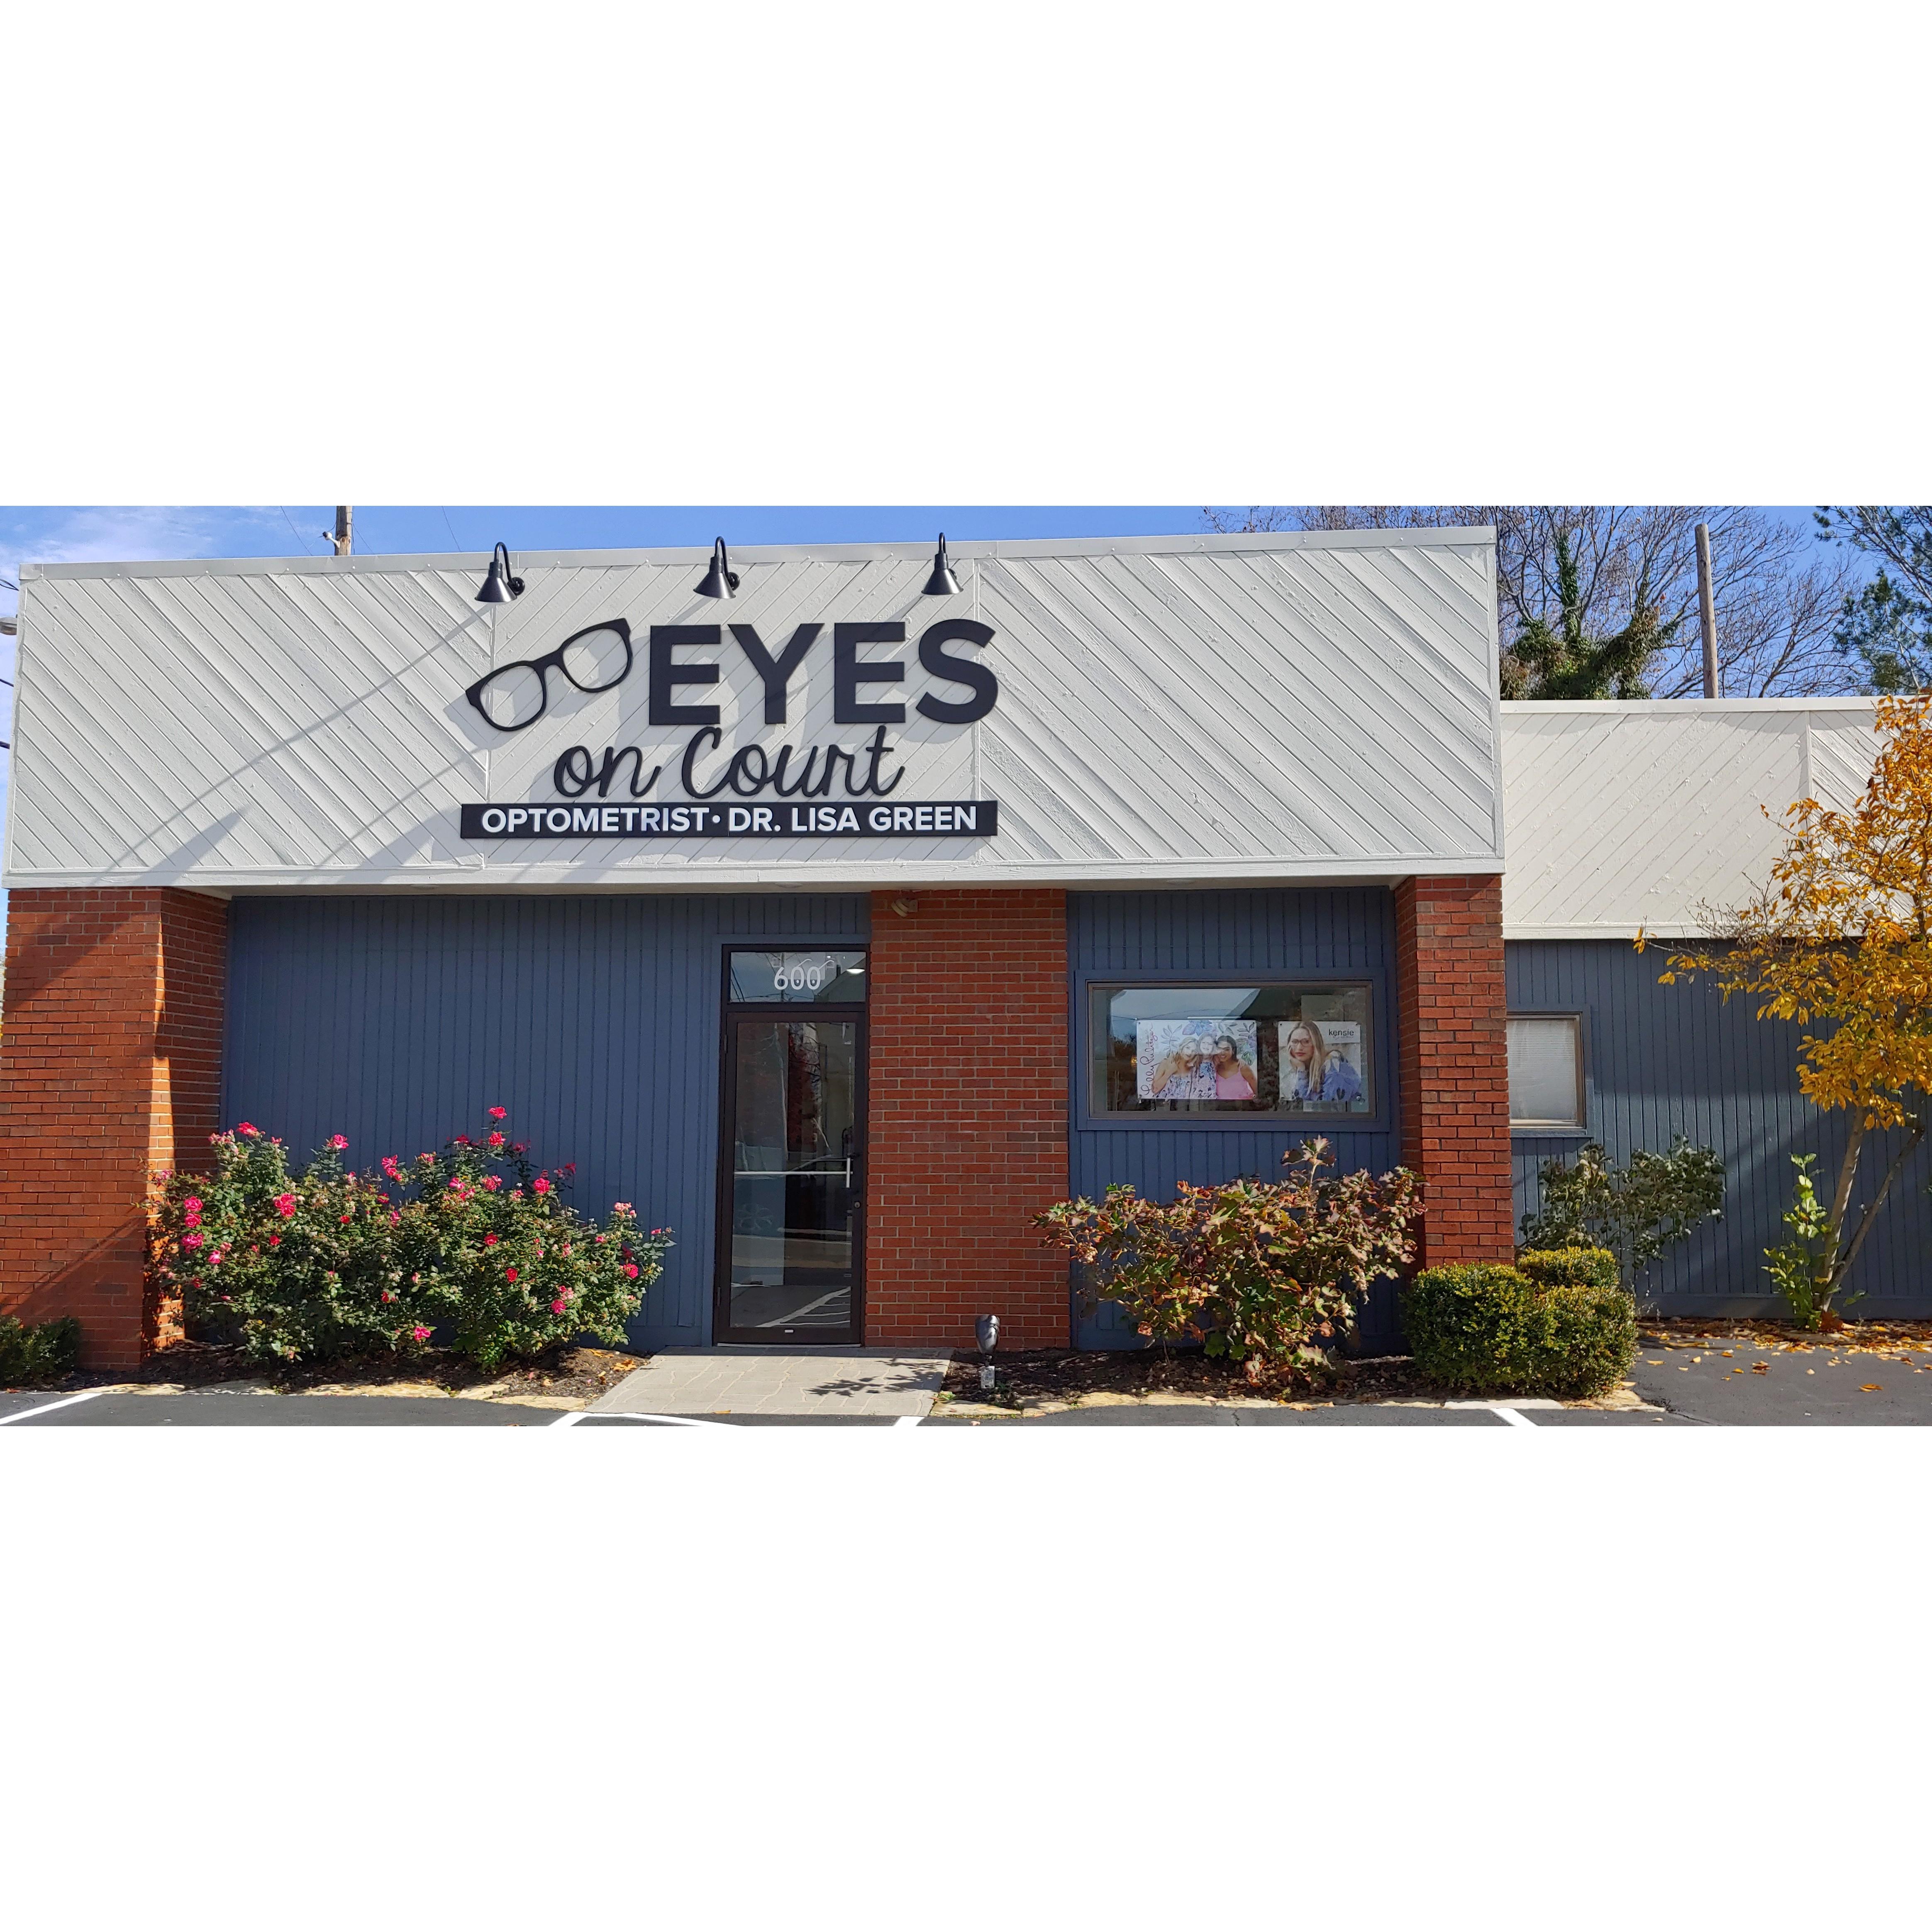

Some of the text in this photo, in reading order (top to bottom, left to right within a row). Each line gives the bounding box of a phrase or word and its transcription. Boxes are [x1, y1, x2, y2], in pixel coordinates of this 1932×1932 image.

[649, 619, 998, 725] EYES
[554, 726, 905, 799] on Court
[481, 805, 977, 833] OPTOMETRIST DR. LISA GREEN
[774, 966, 821, 990] 600
[1141, 1062, 1161, 1095] Llly
